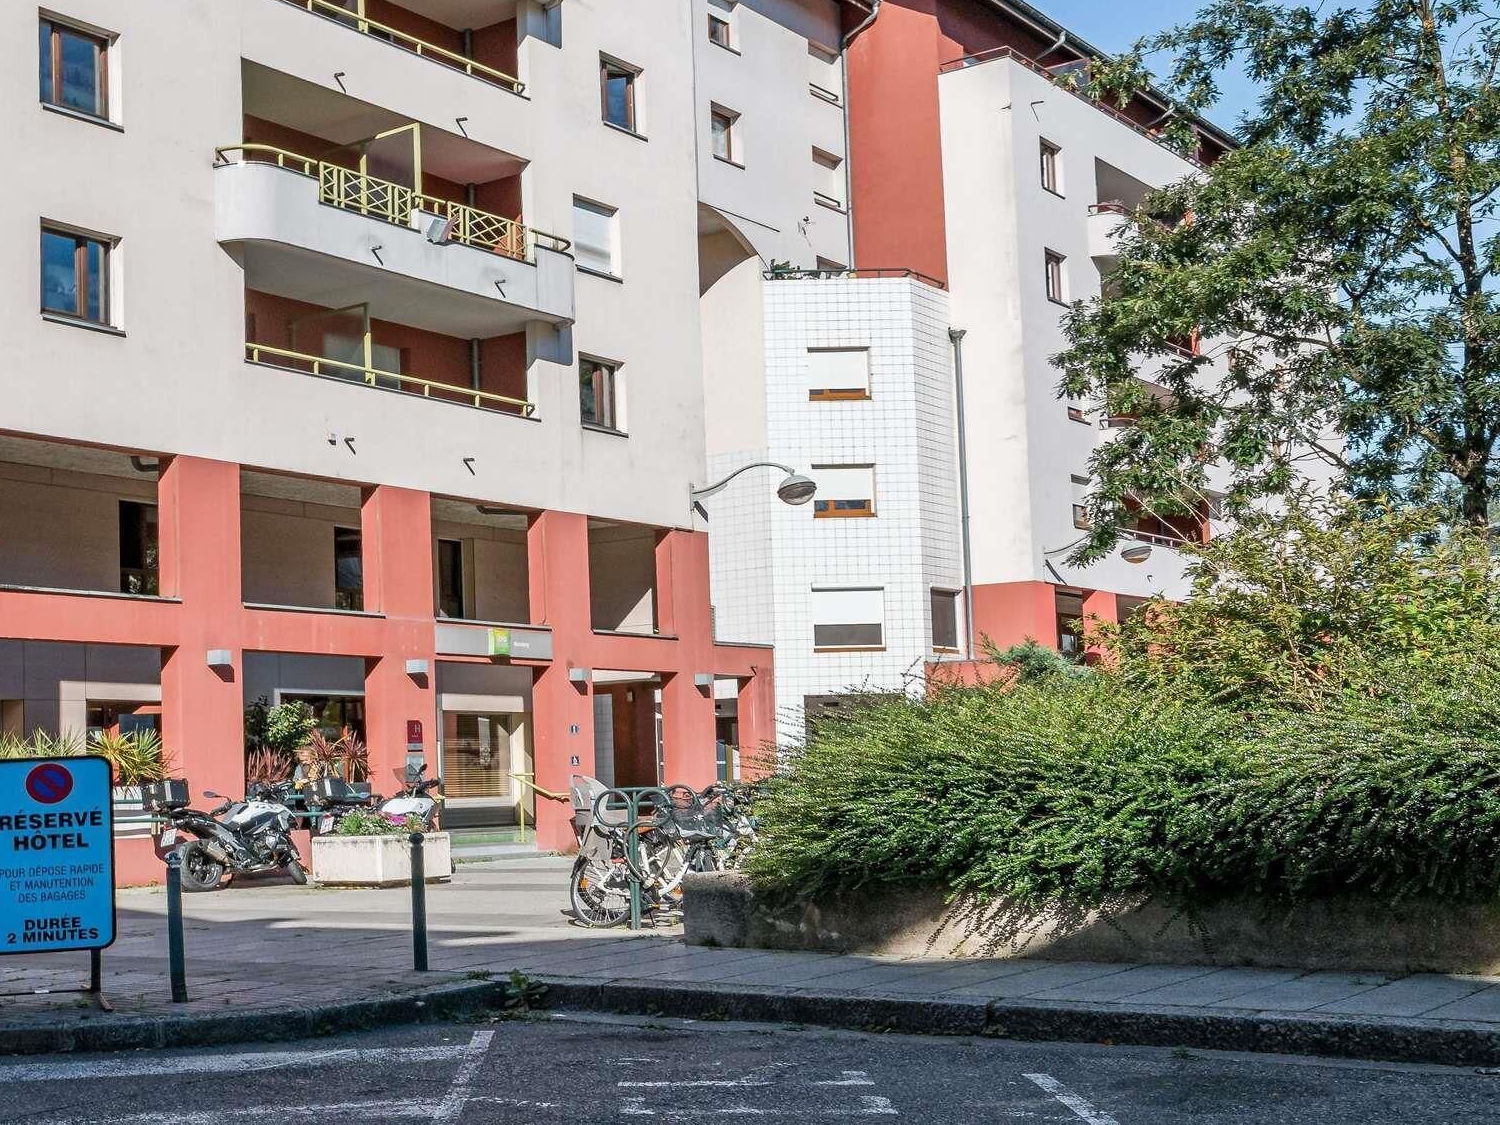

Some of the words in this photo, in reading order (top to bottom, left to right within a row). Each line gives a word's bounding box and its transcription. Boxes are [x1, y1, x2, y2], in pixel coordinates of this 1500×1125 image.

[13, 830, 89, 851] HÔTEL
[28, 863, 67, 877] DÉPOSE
[69, 863, 105, 875] RAPIDE
[9, 880, 21, 891] ET
[24, 877, 94, 890] MANUTENTION
[18, 892, 37, 904] DES
[40, 890, 86, 902] BAGAGES
[24, 913, 81, 931] DURÉE
[7, 933, 17, 944] 2
[23, 928, 99, 943] MINUTES
